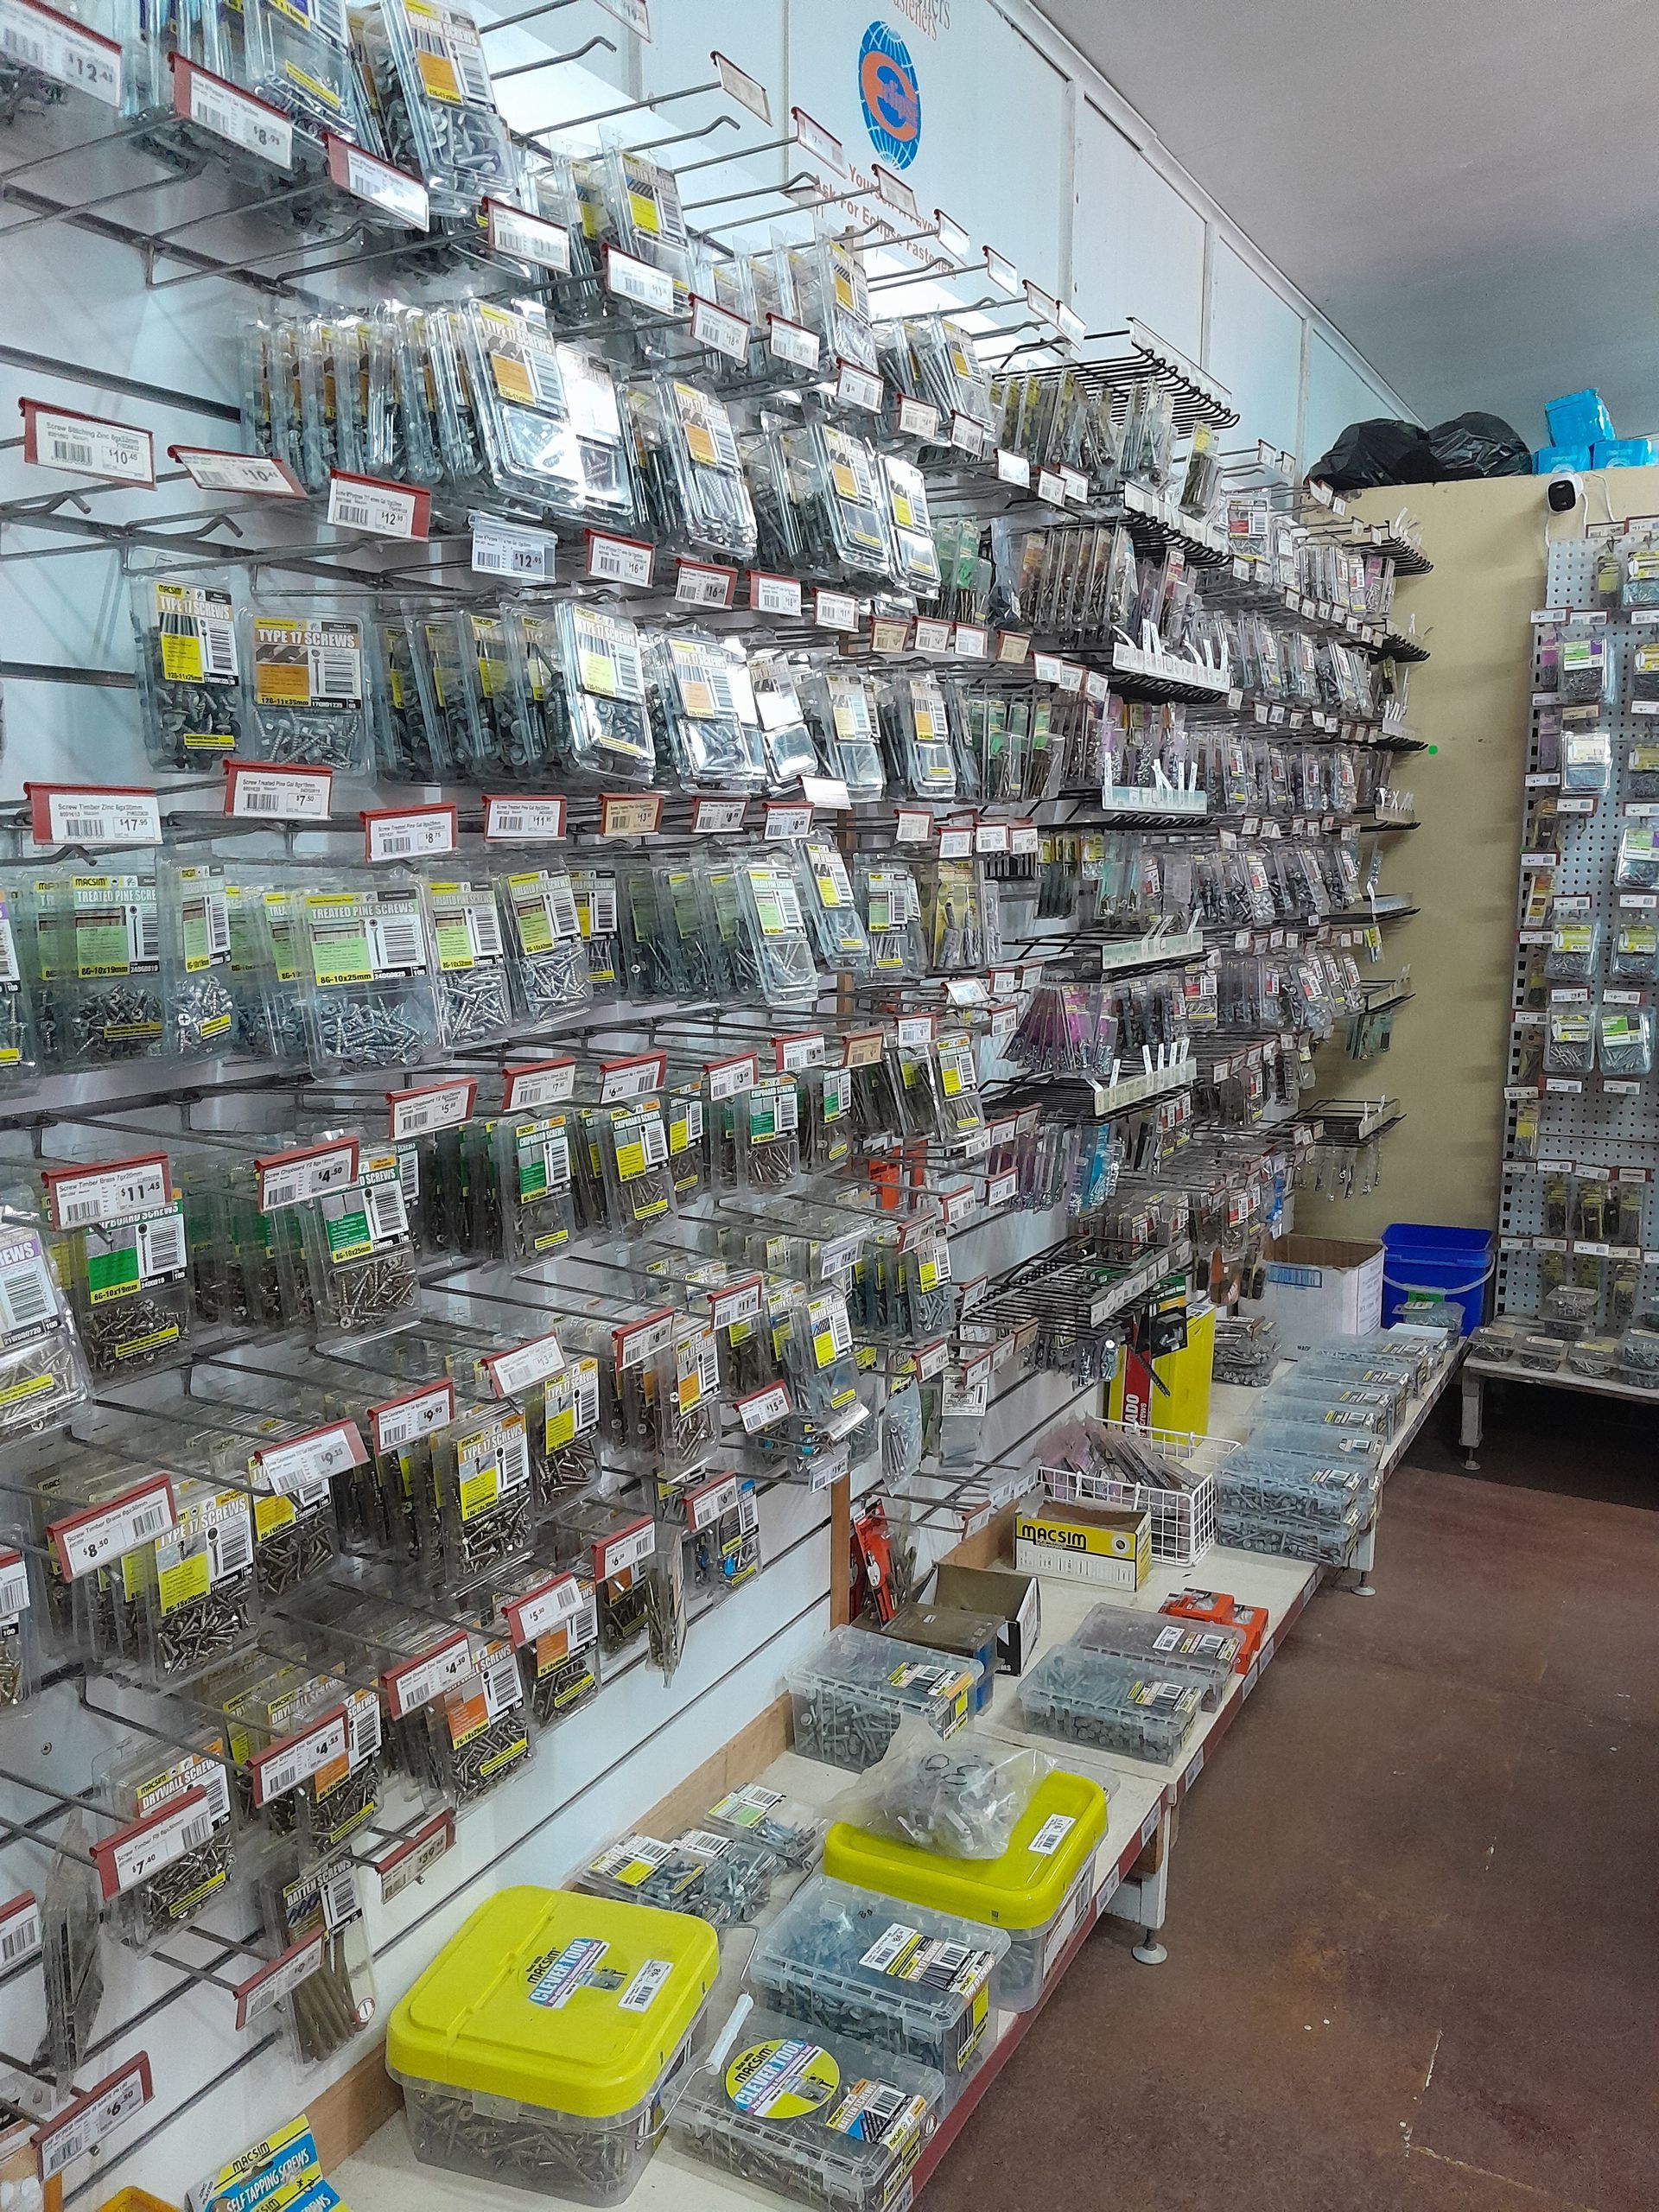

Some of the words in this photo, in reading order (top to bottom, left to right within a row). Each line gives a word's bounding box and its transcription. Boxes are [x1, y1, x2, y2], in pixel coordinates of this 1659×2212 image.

[109, 449, 137, 464] $10.45
[160, 595, 183, 613] TYPE
[184, 599, 193, 613] 17
[193, 601, 230, 620] SCREWS
[258, 628, 288, 643] TYPE
[290, 630, 302, 643] 17
[303, 632, 356, 648] SCREWS
[605, 625, 636, 646] SCREWS
[296, 795, 315, 806] $7.50
[120, 819, 148, 831] $17.95
[425, 832, 442, 844] $8.75
[75, 877, 107, 887] MACSIM
[548, 877, 569, 889] SCREWS
[77, 891, 114, 903] TREATED
[115, 890, 134, 902] PINE
[433, 896, 456, 906] TREATED
[456, 895, 468, 906] PINE
[468, 894, 493, 905] SCREWS
[312, 906, 351, 919] TREATED
[353, 905, 373, 917] PINE
[375, 902, 414, 915] SCREWS
[321, 973, 372, 984] 8G-10x25mm
[642, 1111, 661, 1122] SCREWS
[519, 1133, 545, 1147] CHIPBOARD
[545, 1128, 566, 1141] SCREWS
[318, 1166, 343, 1182] $4.50
[366, 1168, 396, 1185] SCREWS
[79, 1180, 99, 1190] Timber
[120, 1181, 161, 1202] $11.45
[336, 1245, 371, 1260] 8G-10x25mm
[93, 1283, 138, 1300] 8G-10x19mm
[46, 1320, 58, 1330] 100
[547, 1384, 563, 1400] TYPE
[563, 1382, 570, 1394] 17
[570, 1370, 596, 1391] SCREWS
[462, 1442, 481, 1461] TYPE
[483, 1439, 491, 1453] 17
[492, 1424, 524, 1451] SCREWS
[67, 1532, 85, 1542] Screw
[86, 1520, 105, 1535] Timber
[105, 1513, 122, 1525] Brass
[161, 1526, 187, 1548] TYPE
[189, 1519, 200, 1534] 17
[200, 1497, 247, 1529] SCREWS
[82, 1537, 109, 1558] $8.50
[1021, 1524, 1087, 1551] MACSIM
[243, 1565, 253, 1577] 100
[165, 1591, 207, 1614] 8G-15x20mm
[3, 1628, 16, 1637] 100
[480, 1644, 512, 1670] SCREWS
[347, 1692, 377, 1719] SCREWS
[140, 1774, 168, 1795] MACSIM
[143, 1774, 184, 1810] DRYWALL
[118, 1849, 133, 1861] Screw
[132, 1853, 156, 1875] $7.40
[287, 1881, 317, 1907] BATTEN
[317, 1859, 353, 1887] SCREWS
[527, 1948, 562, 1985] MACSIM
[734, 2047, 773, 2083] MACSIM
[106, 2090, 134, 2116] $6.50
[857, 2083, 877, 2108] SCREWS
[232, 2141, 270, 2174] MACSIM
[226, 2190, 245, 2212] SELF
[245, 2174, 280, 2203] TAPPING
[278, 2147, 310, 2177] SCREWS
